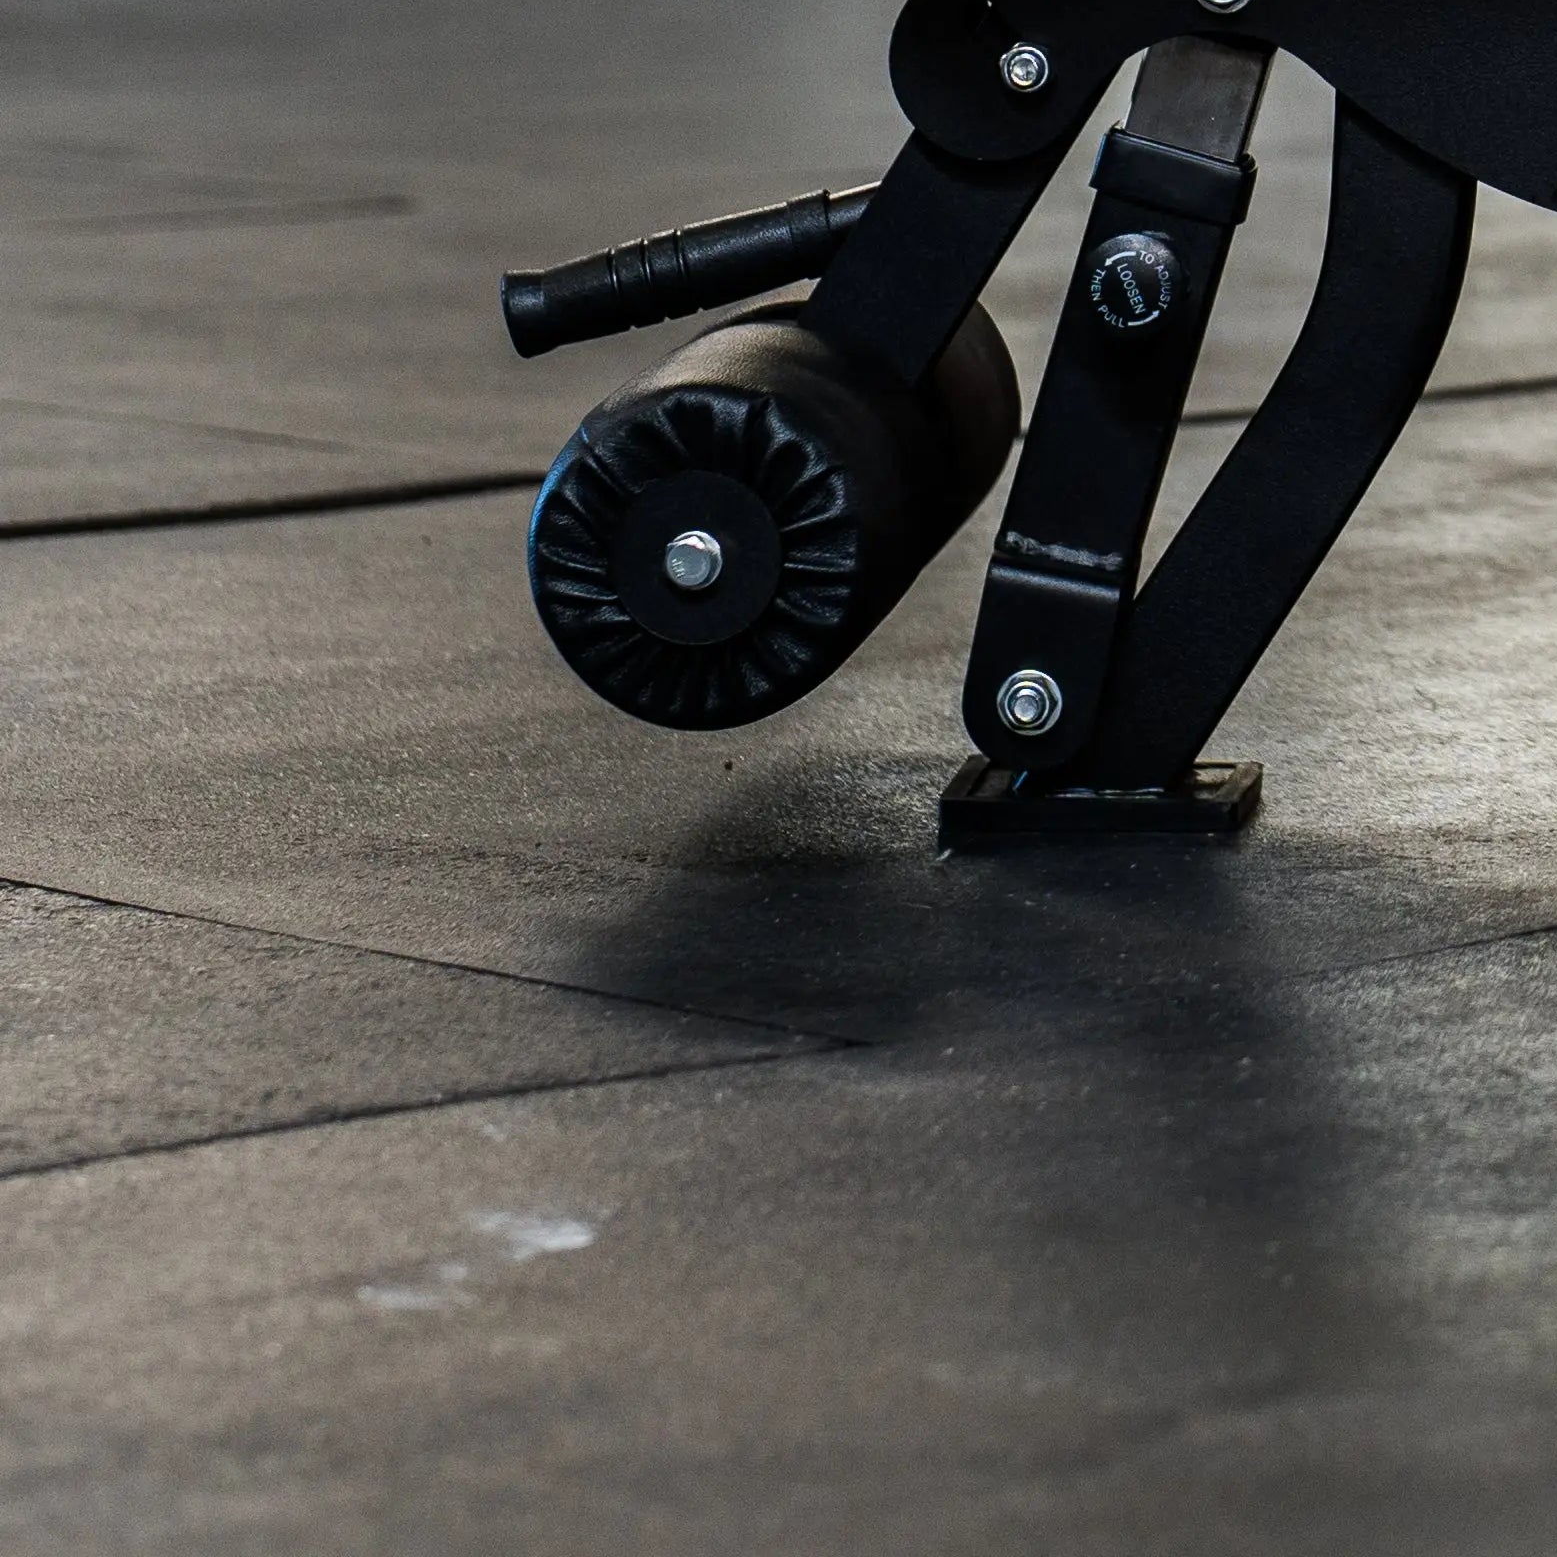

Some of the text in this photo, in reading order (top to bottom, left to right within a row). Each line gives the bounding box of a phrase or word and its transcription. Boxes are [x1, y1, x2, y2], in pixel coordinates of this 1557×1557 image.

[1091, 269, 1125, 328] THEN PULL
[1117, 263, 1146, 314] LOOSEN
[1139, 250, 1171, 309] TO ADJUST
